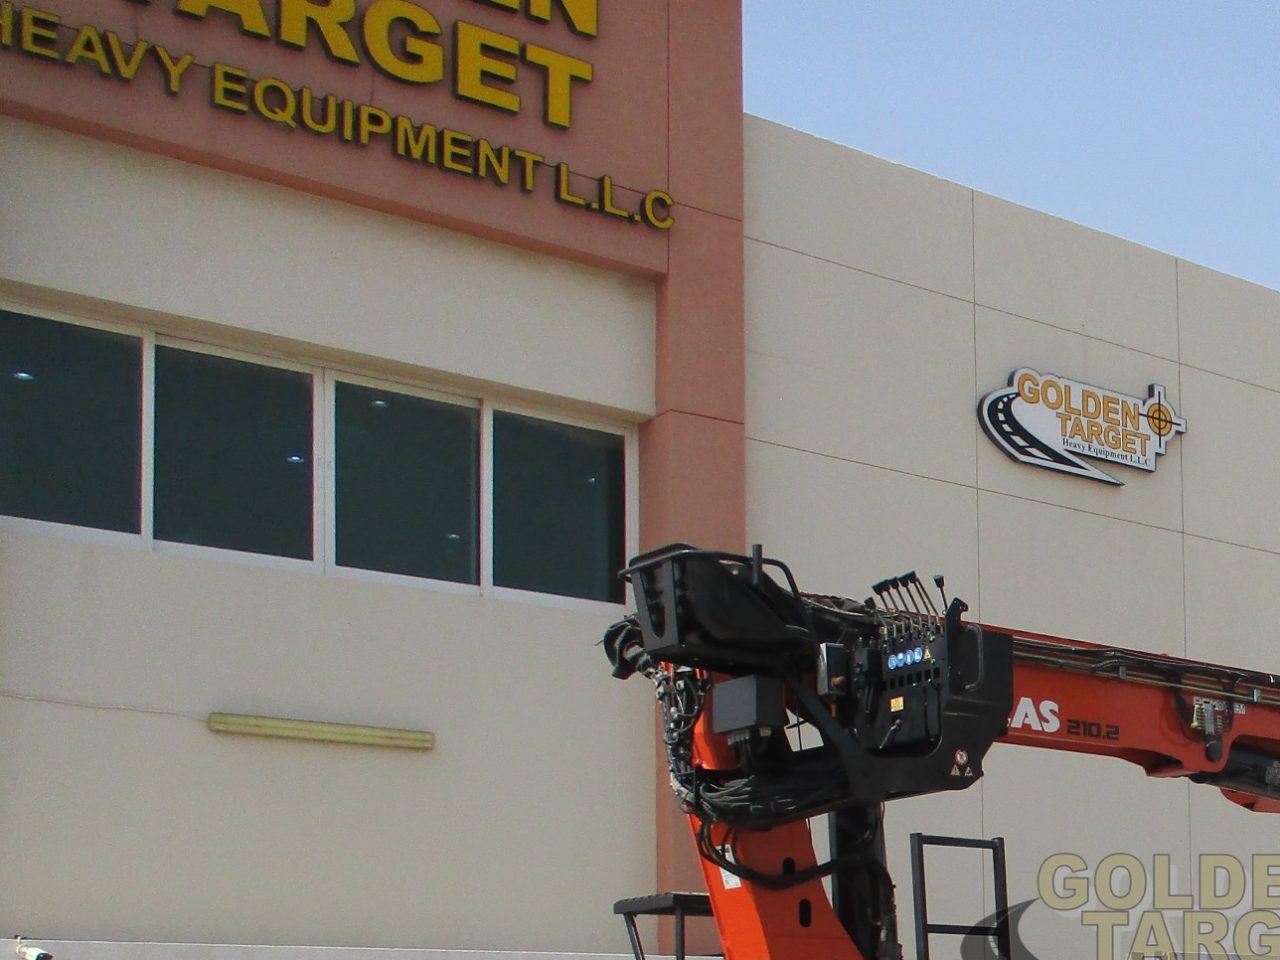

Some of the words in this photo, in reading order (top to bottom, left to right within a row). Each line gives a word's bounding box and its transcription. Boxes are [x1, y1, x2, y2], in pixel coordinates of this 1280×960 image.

[122, 0, 594, 129] RGET
[212, 62, 545, 192] EQUIPMENT
[555, 162, 676, 231] L.L.C
[1018, 374, 1140, 431] GOLDEN
[1056, 412, 1151, 456] TARGET
[1062, 437, 1086, 452] Heavy
[1087, 443, 1128, 461] Equipment
[1007, 697, 1060, 733] AS
[1067, 719, 1120, 741] 210.2
